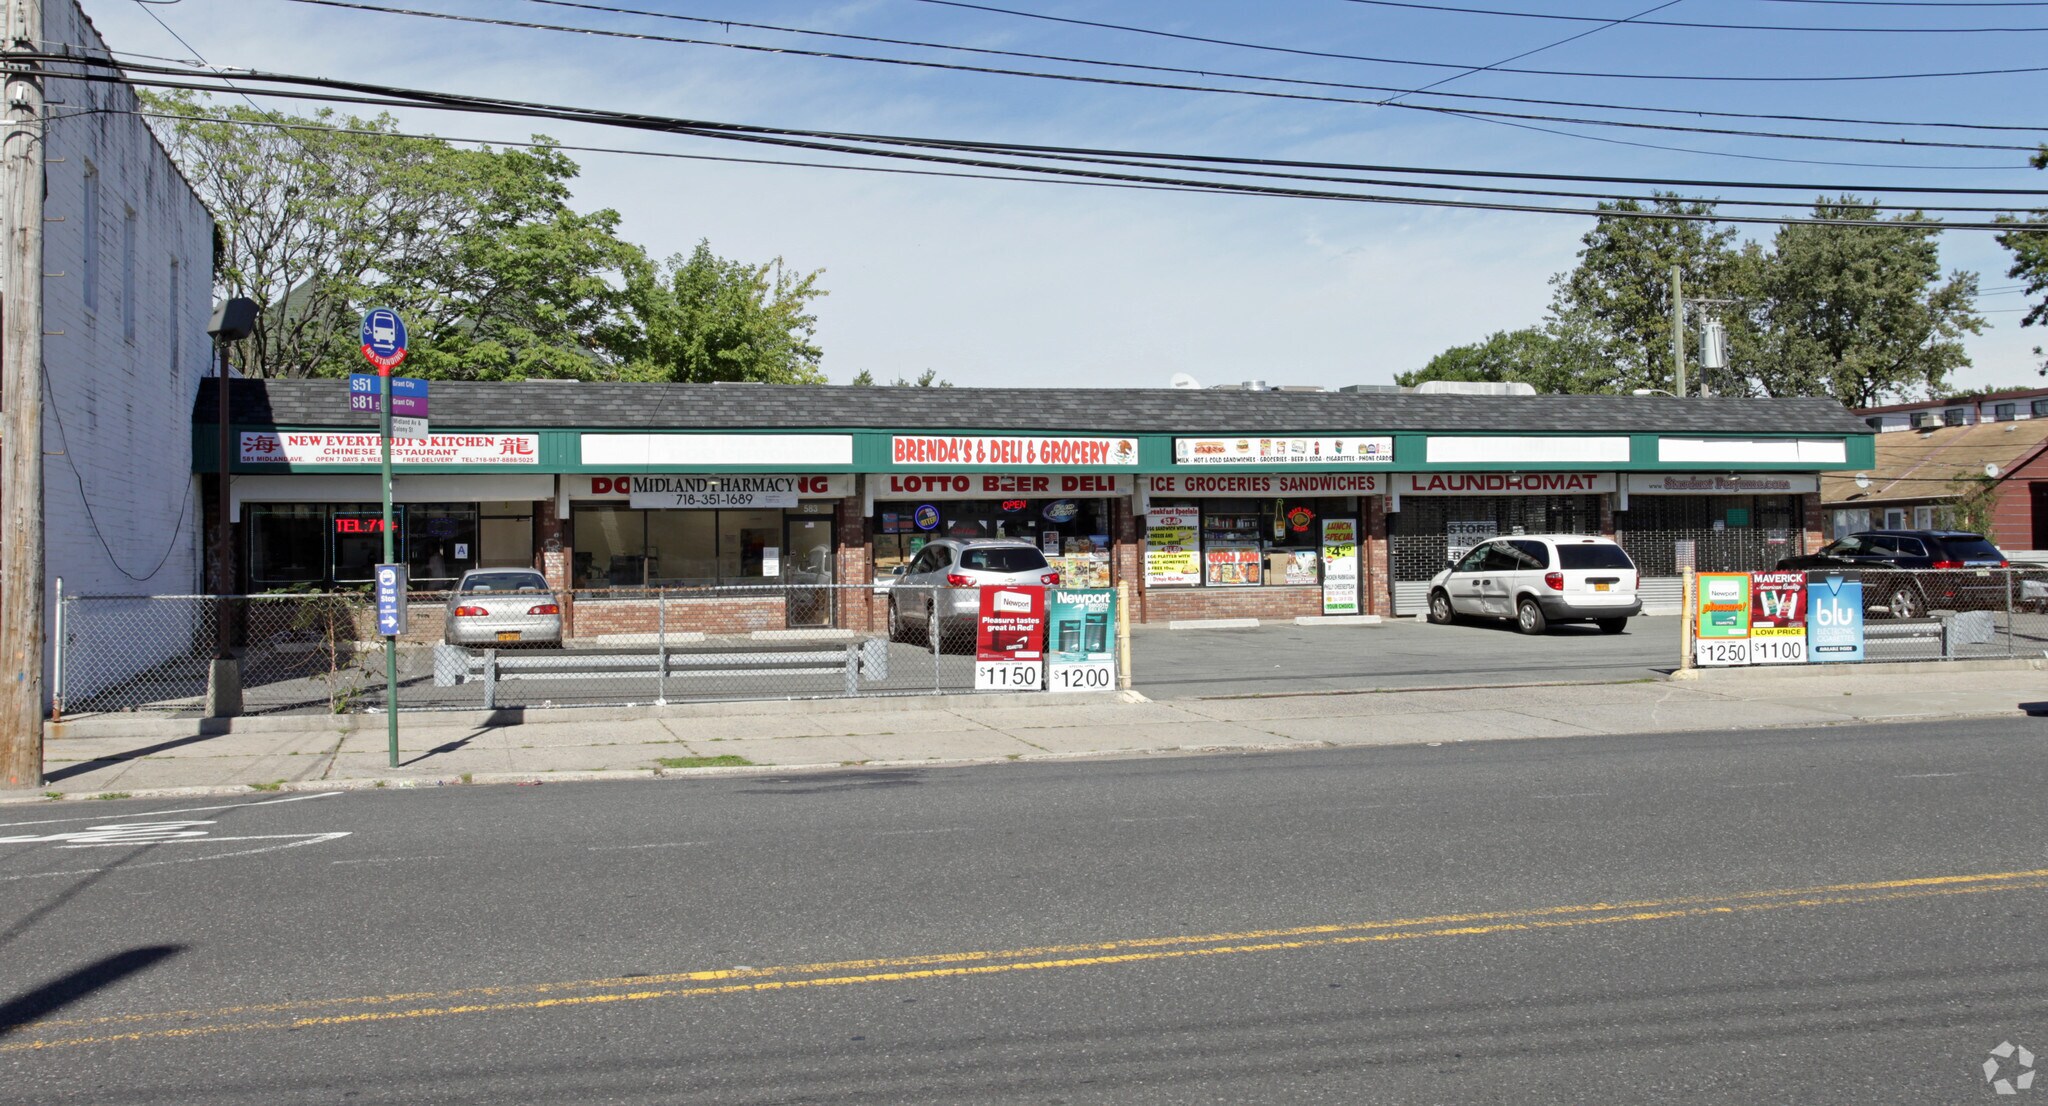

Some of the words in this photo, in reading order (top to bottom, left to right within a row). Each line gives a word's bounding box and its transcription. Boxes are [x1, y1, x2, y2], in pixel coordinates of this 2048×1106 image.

[366, 347, 374, 358] NO
[374, 352, 404, 366] STANDING
[352, 378, 371, 392] S51
[406, 381, 415, 389] City
[352, 395, 372, 409] S81
[392, 398, 405, 406] Grant
[406, 399, 415, 407] City
[242, 435, 280, 453] 海
[288, 435, 322, 446] NEW
[326, 435, 427, 447] EVERYBDYS
[430, 436, 494, 447] KITCHEN
[499, 437, 533, 455] 龍
[894, 438, 972, 463] BRENDA'S
[976, 439, 986, 463] &
[990, 440, 1022, 463] DELI
[1027, 440, 1036, 464] &
[1040, 440, 1109, 465] GROCERY
[633, 477, 707, 493] MIDLAND
[891, 475, 970, 492] LOTTO
[983, 476, 1050, 492] BEER
[1062, 476, 1114, 491] DELI
[1151, 476, 1175, 491] ICE
[1185, 476, 1270, 491] GROCERIES
[1280, 476, 1375, 491] SANDWICHES
[1412, 474, 1597, 490] LAUNDROMAT
[1664, 476, 1713, 490] Stardust
[1715, 476, 1791, 492] Perfume.com
[676, 494, 753, 505] 718-351-1689
[1002, 500, 1026, 510] OPEN
[336, 518, 398, 533] TEL:71-
[1449, 524, 1495, 534] STORE
[457, 546, 465, 555] A
[1754, 574, 1803, 583] MAVERICK
[1783, 583, 1801, 591] Quality
[1004, 598, 1029, 608] Newport
[1057, 592, 1110, 606] Newport
[1702, 602, 1747, 614] pleasure!
[1817, 598, 1853, 626] blu
